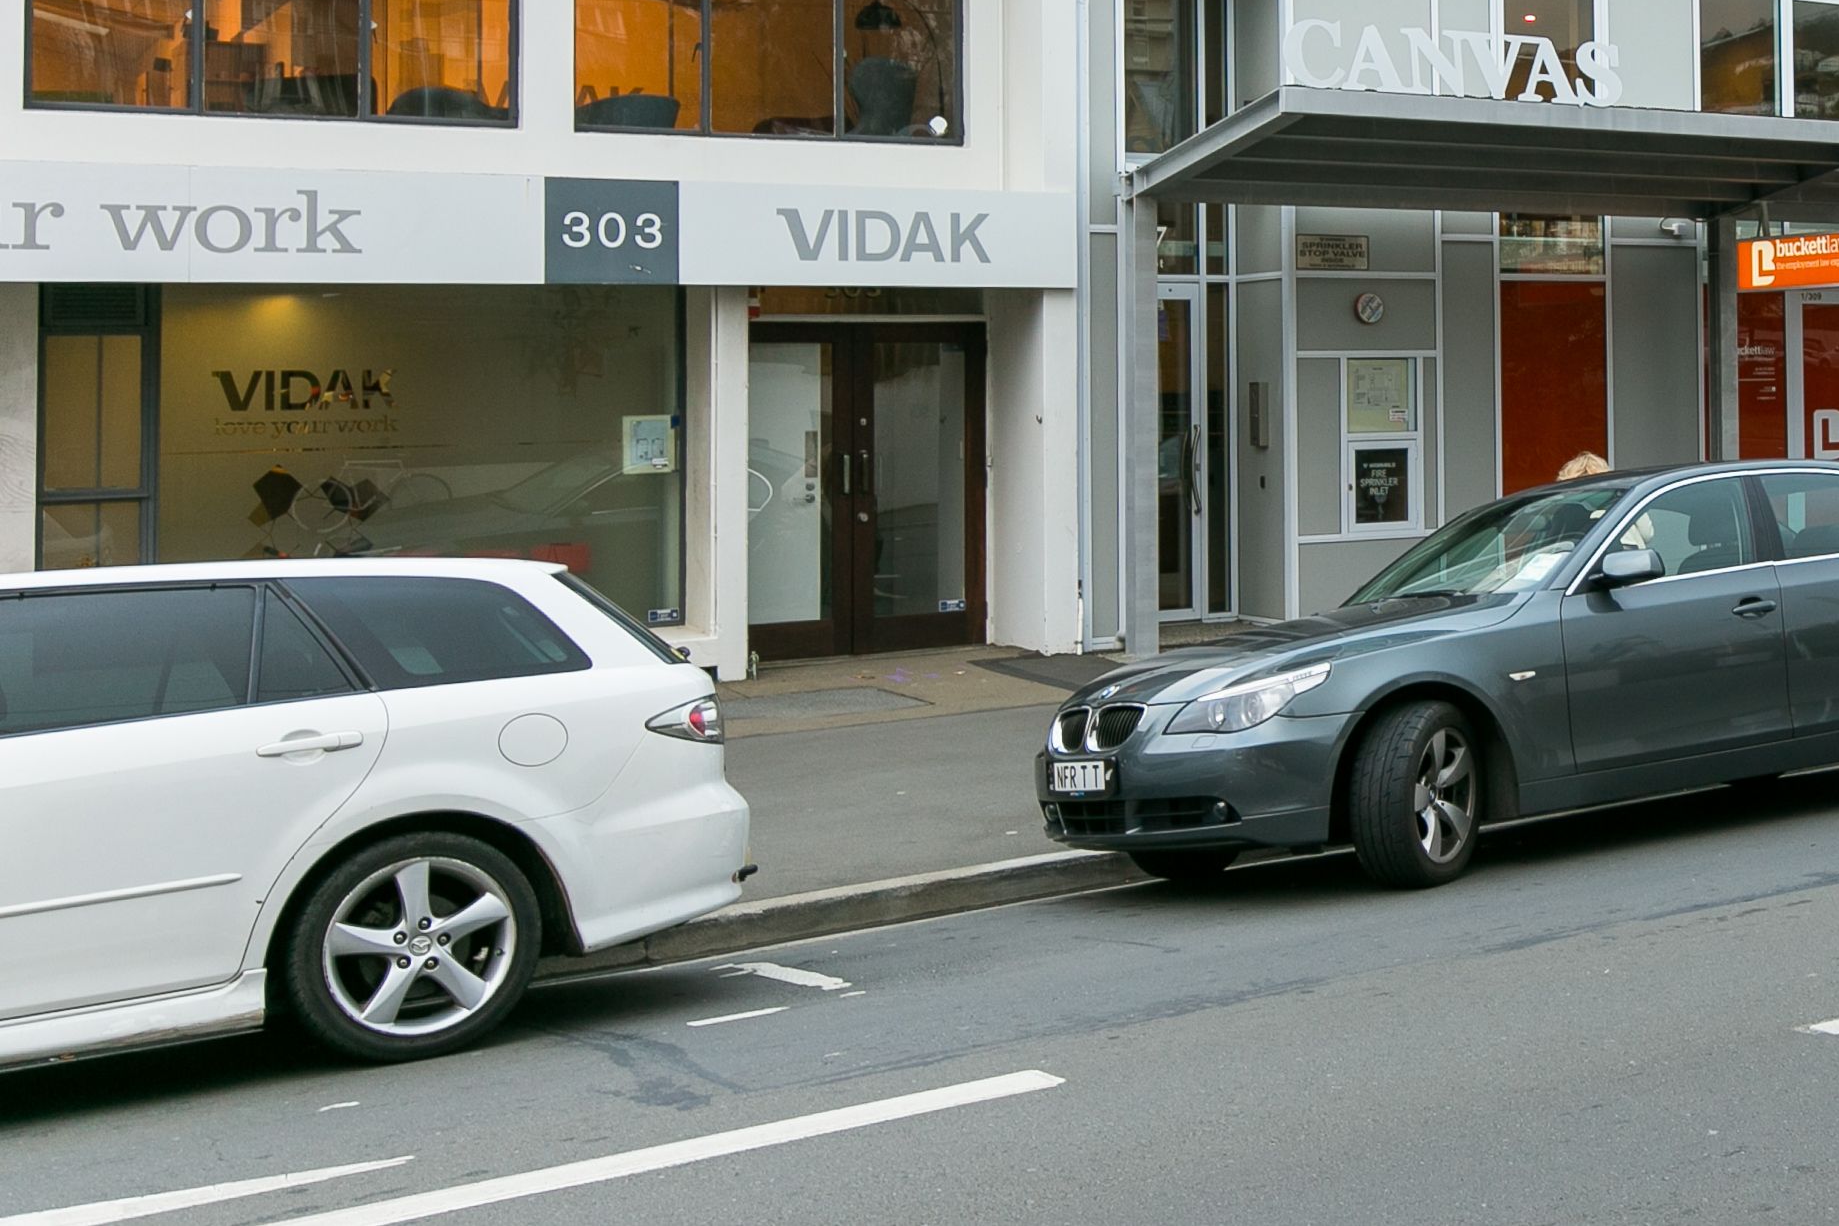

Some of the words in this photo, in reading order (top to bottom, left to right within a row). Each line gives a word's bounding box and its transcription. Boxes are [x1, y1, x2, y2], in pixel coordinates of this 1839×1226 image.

[1283, 18, 1622, 107] CANVAS
[0, 202, 65, 250] r
[100, 190, 363, 254] work
[562, 211, 664, 249] 303
[776, 208, 992, 264] VIDAK
[1302, 242, 1363, 250] SPRINKLER
[1332, 250, 1366, 258] VALVE
[212, 369, 398, 411] VIDAK
[215, 417, 266, 436] love
[337, 415, 400, 434] work
